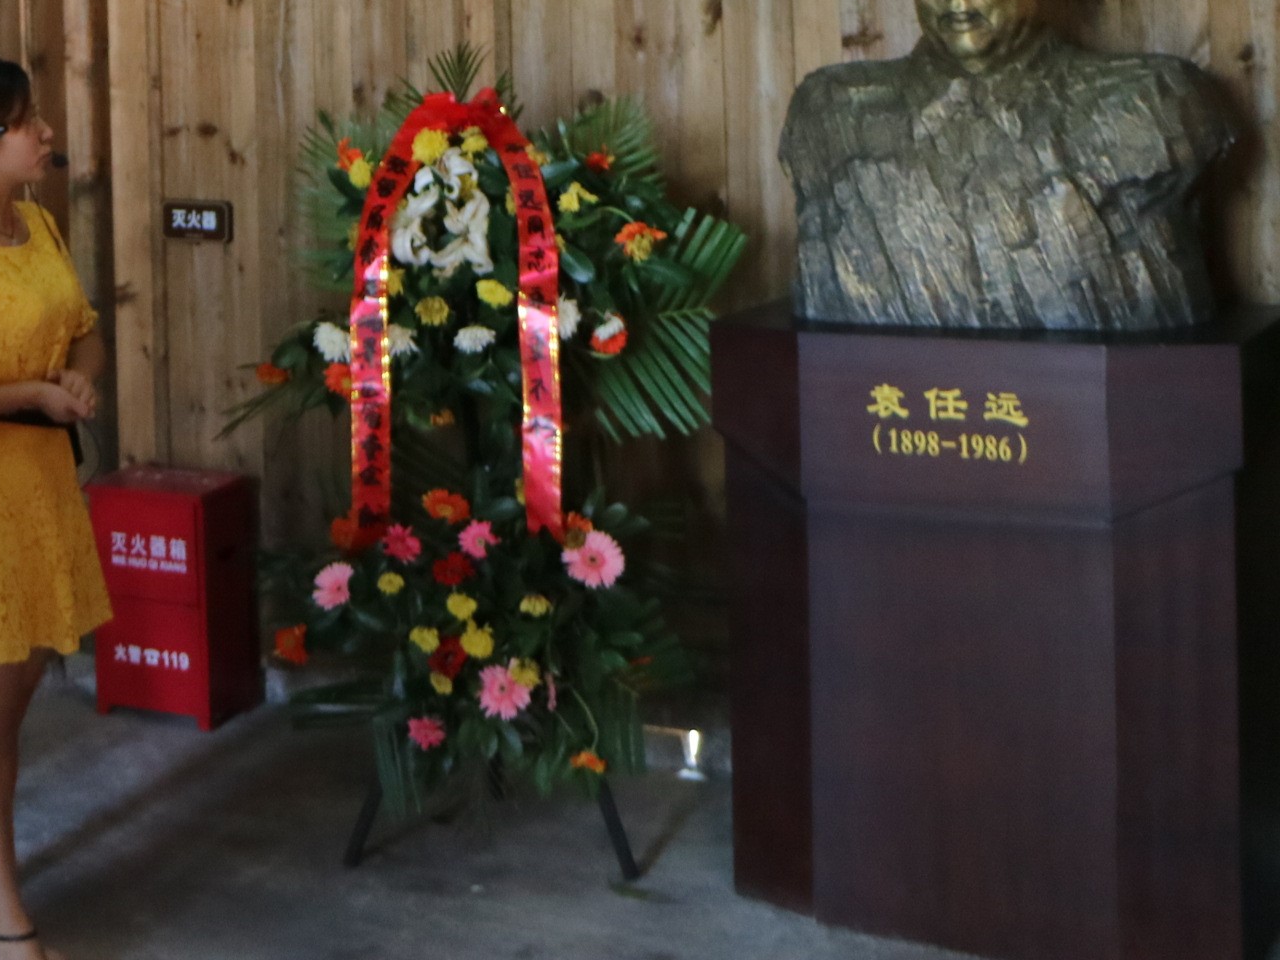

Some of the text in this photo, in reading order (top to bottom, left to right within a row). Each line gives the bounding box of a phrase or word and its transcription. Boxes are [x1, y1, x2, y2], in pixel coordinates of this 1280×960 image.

[172, 208, 217, 231] 灭火器
[866, 382, 1030, 428] 袁任远
[871, 423, 1028, 465] (1898-1986)
[111, 531, 187, 561] 灭火器箱
[161, 649, 190, 671] 119
